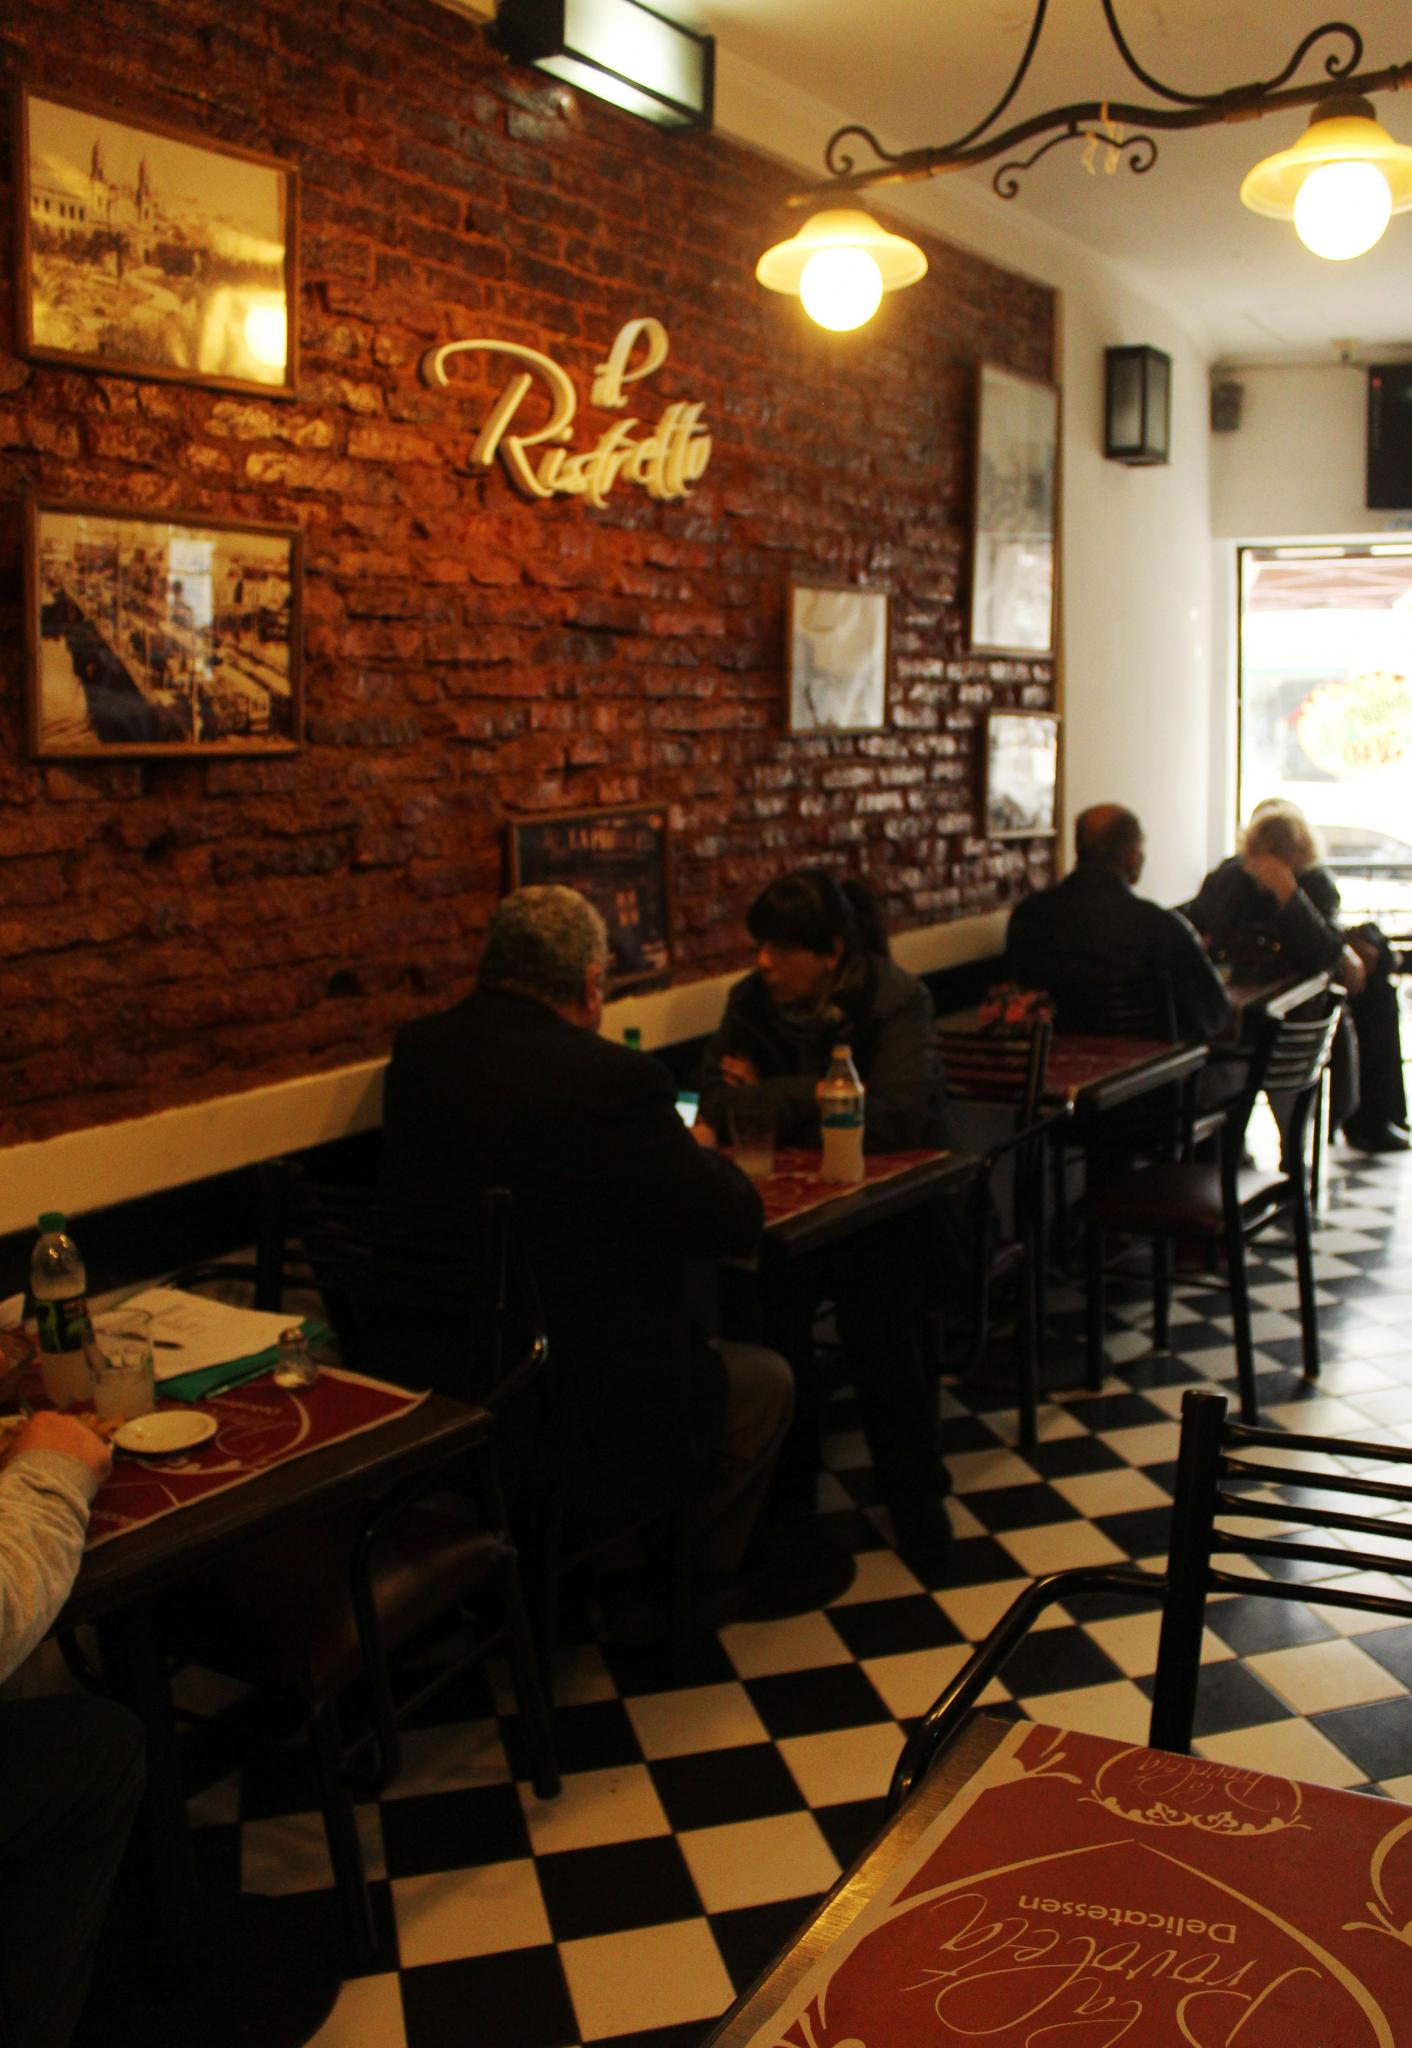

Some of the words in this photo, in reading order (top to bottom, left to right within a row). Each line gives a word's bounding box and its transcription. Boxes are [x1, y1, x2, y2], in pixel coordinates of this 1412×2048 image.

[424, 338, 712, 509] Ristretto
[899, 1893, 1323, 2048] Provoleta
[1018, 1894, 1237, 1944] Delicatessen
